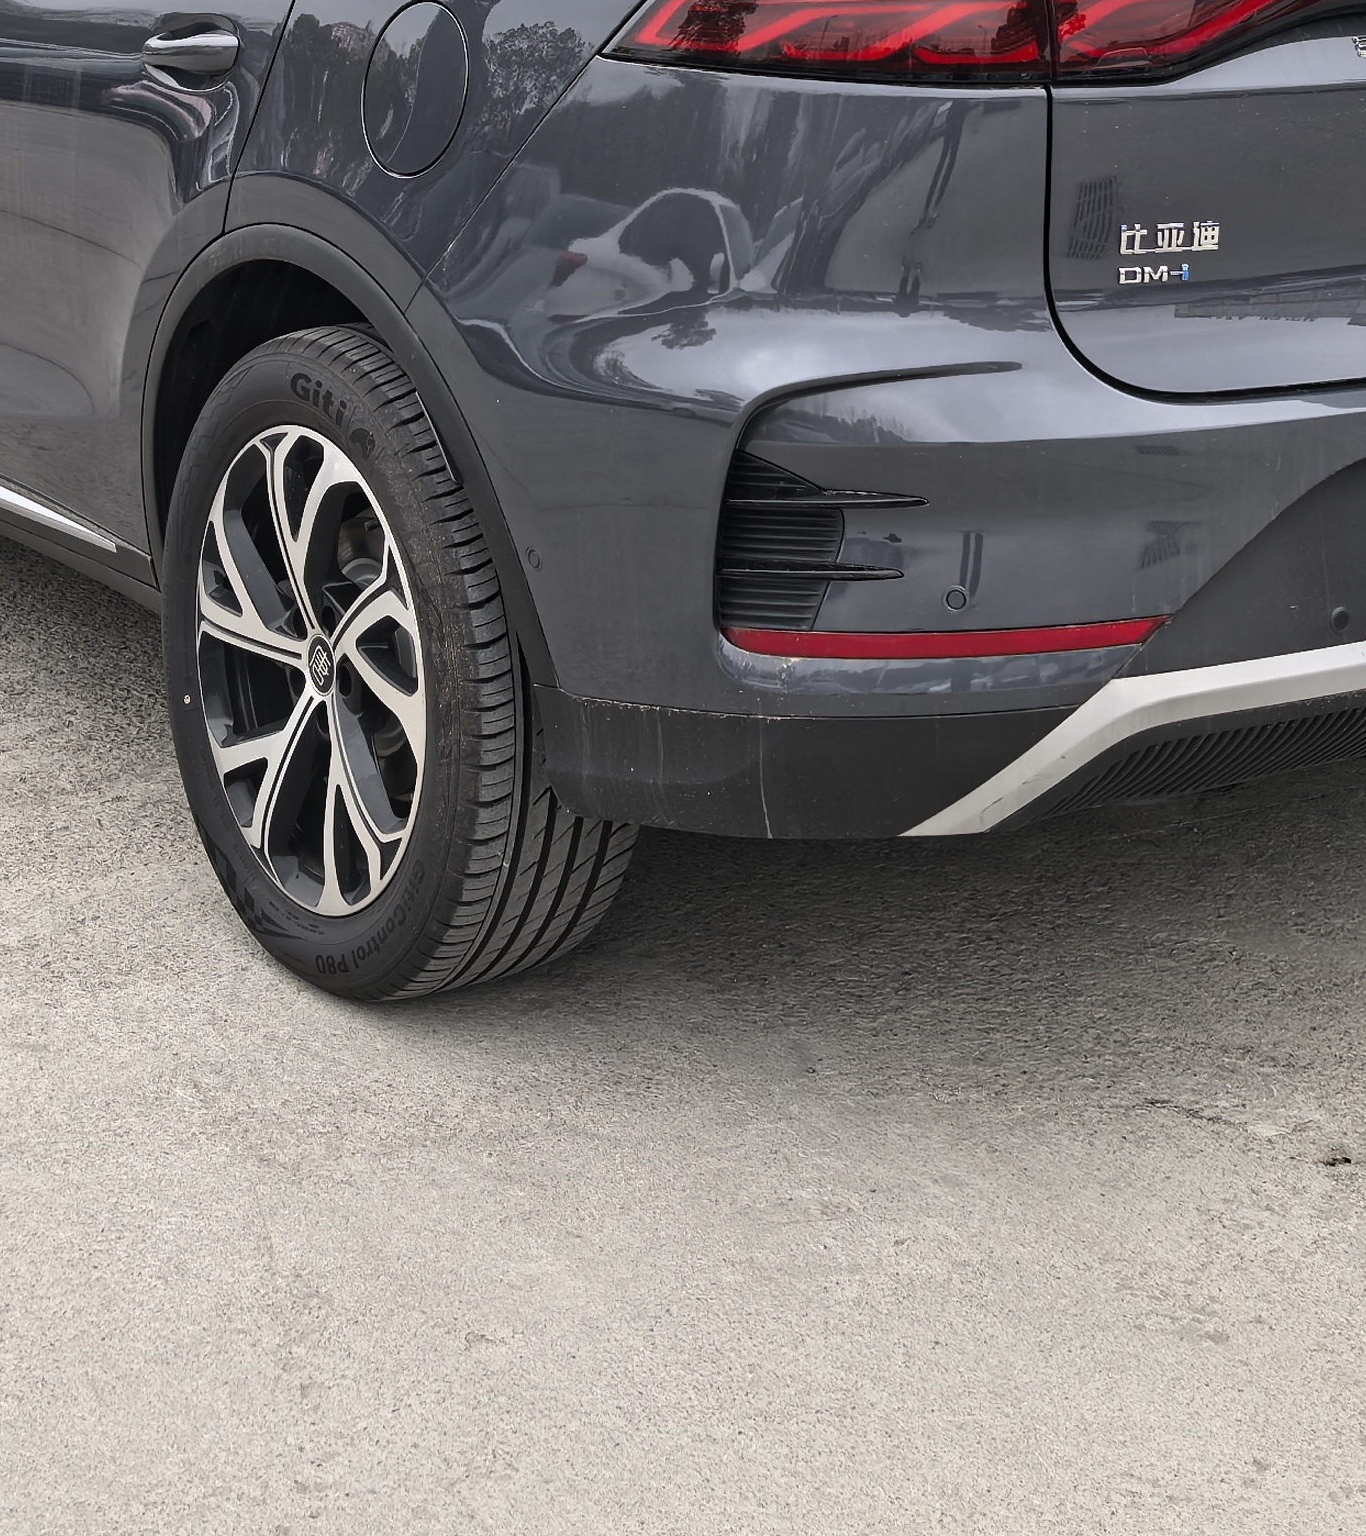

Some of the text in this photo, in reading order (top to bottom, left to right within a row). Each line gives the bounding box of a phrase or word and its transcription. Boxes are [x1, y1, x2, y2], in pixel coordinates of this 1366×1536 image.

[1120, 220, 1220, 255] 比亚迪
[1118, 263, 1190, 285] DM-i
[290, 372, 348, 429] Giti
[315, 952, 350, 975] P80
